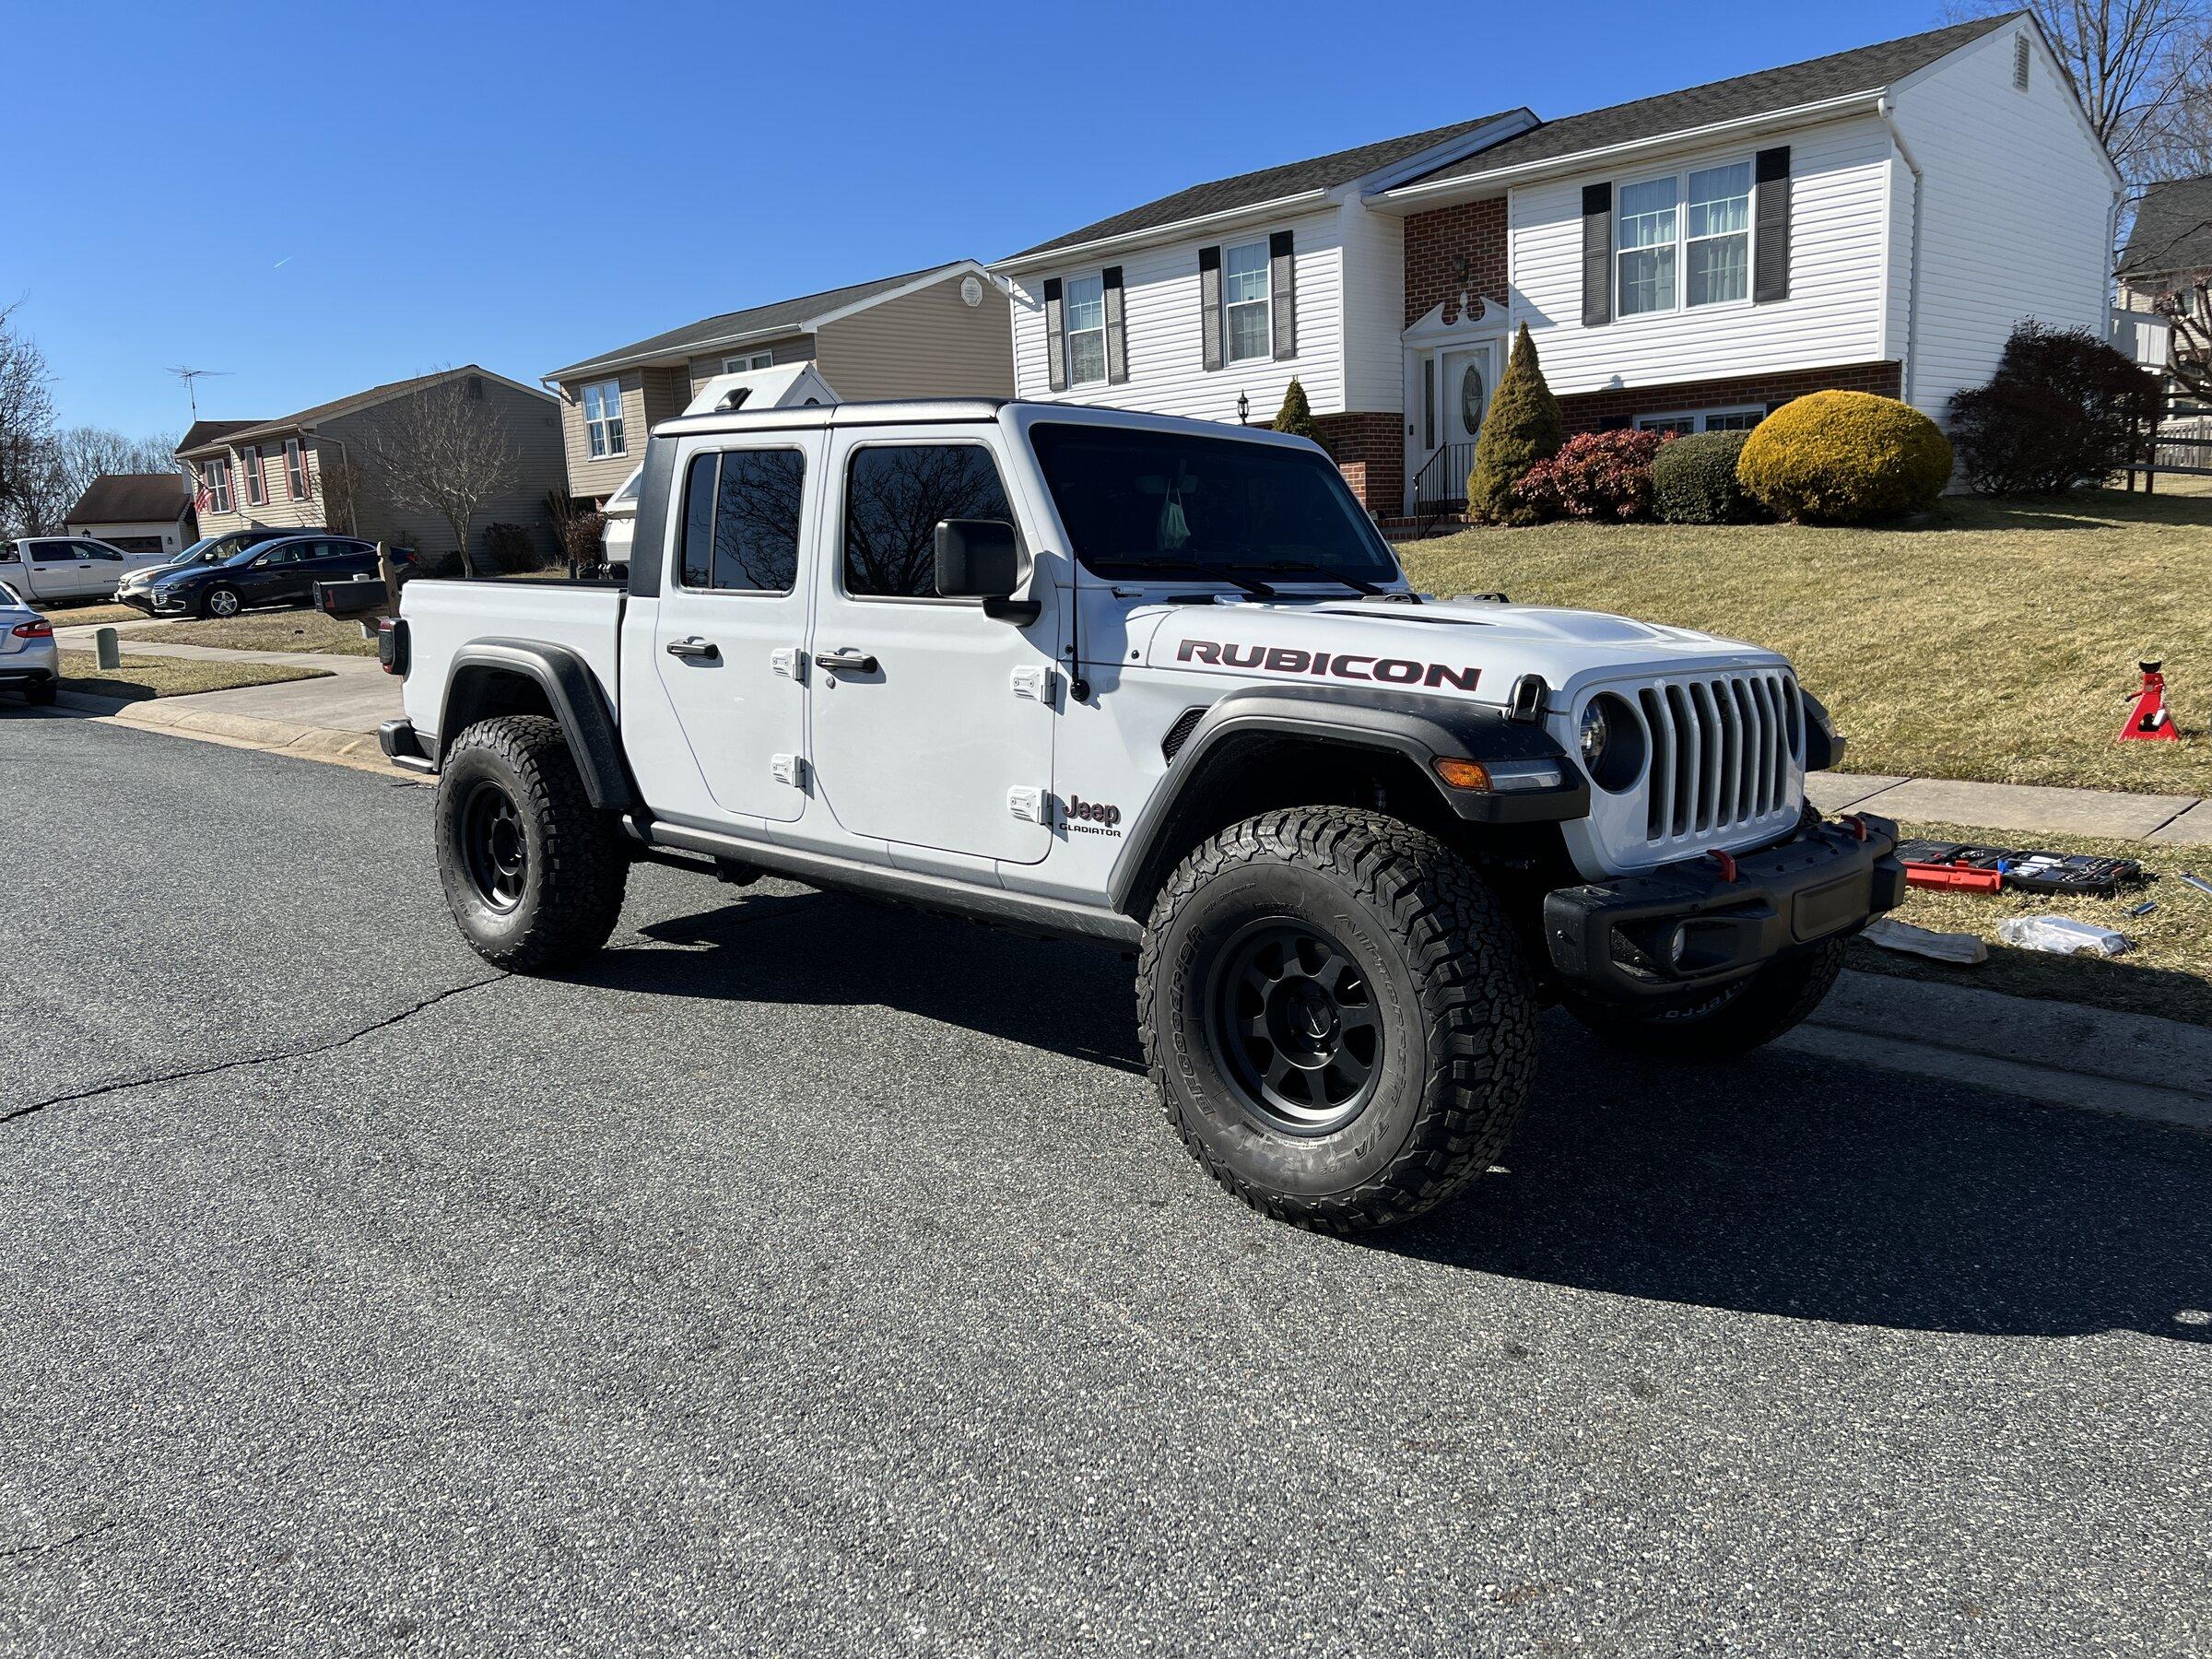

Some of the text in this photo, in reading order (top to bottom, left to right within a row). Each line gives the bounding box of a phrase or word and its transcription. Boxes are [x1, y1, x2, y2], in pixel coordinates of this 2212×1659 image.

[1177, 639, 1482, 691] RUBICON
[1059, 822, 1122, 838] GLADIATOR
[1062, 794, 1121, 829] Jeep
[1169, 924, 1217, 1116] BFGoodrich
